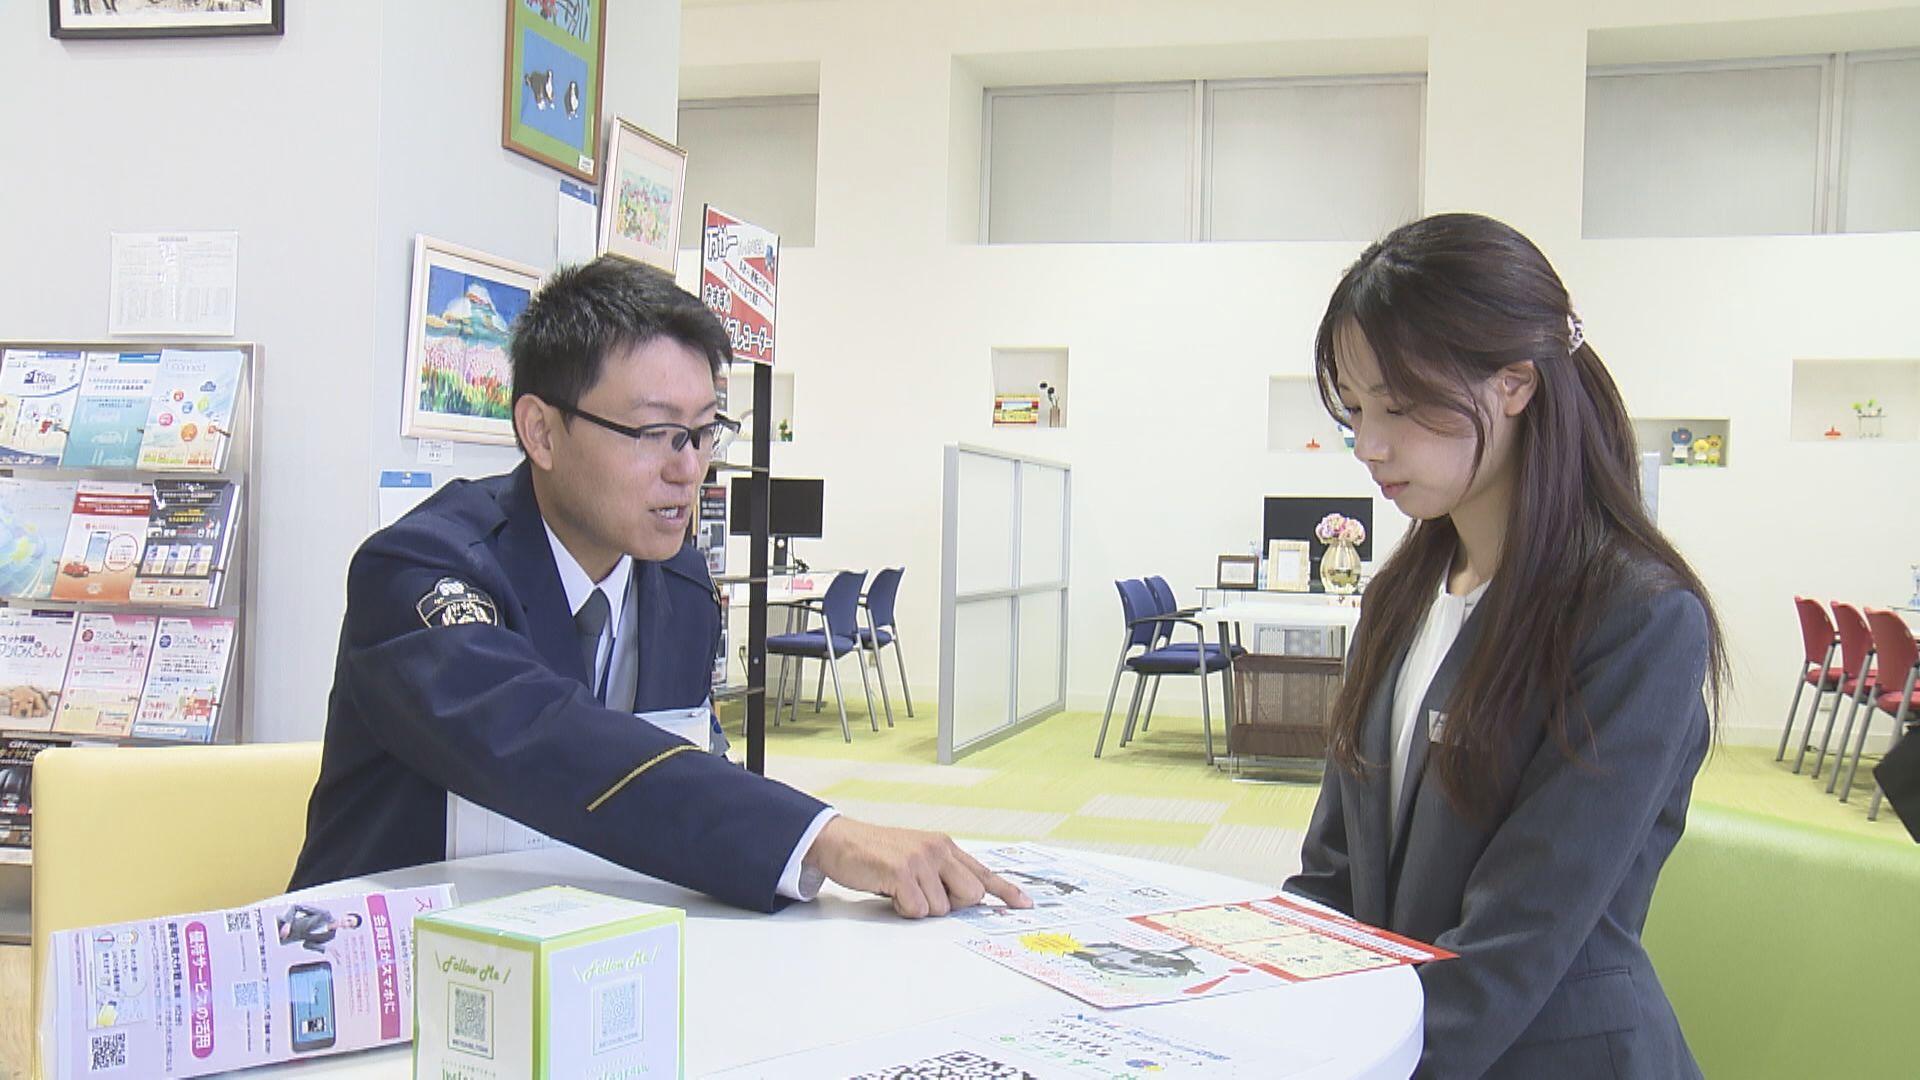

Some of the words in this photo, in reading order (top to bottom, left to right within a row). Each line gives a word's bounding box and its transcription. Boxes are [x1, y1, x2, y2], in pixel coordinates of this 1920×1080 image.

[373, 914, 397, 1014] 会員証がスマホに
[443, 956, 478, 974] Follow
[479, 964, 500, 981] Me
[585, 960, 624, 981] Follow
